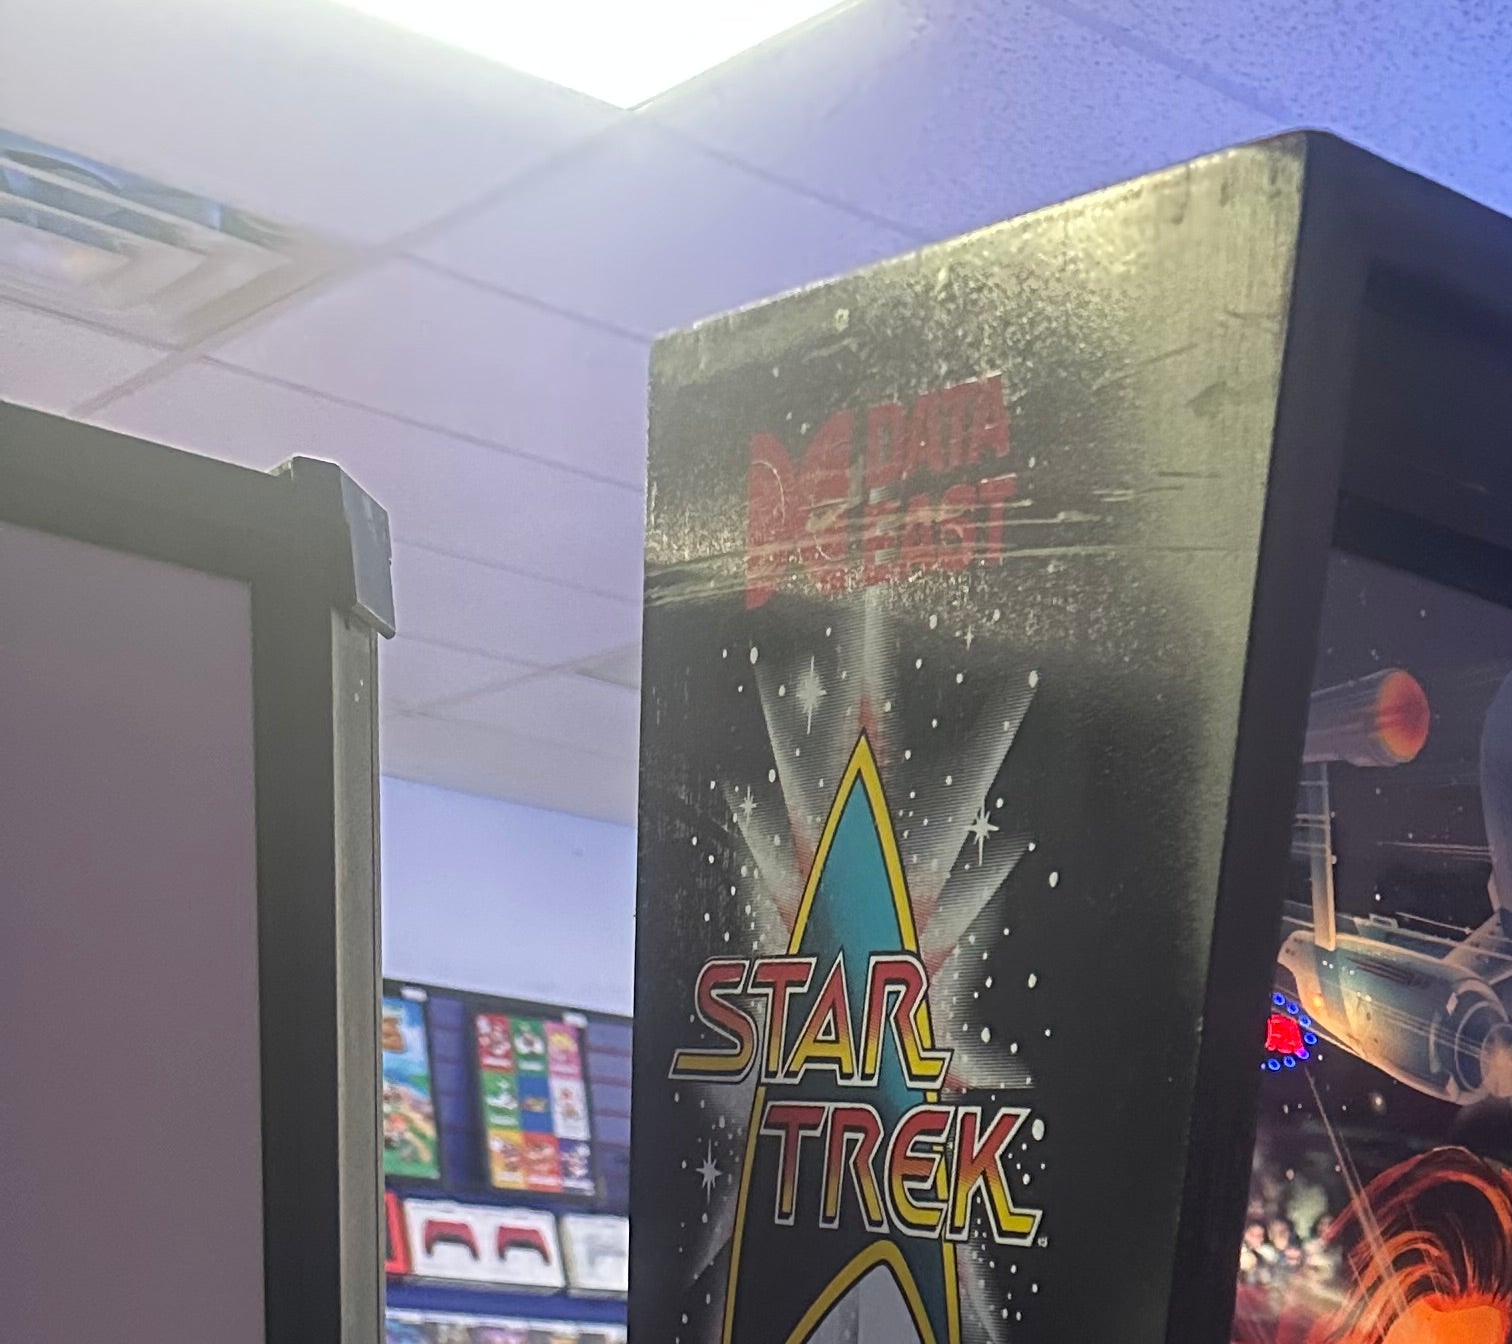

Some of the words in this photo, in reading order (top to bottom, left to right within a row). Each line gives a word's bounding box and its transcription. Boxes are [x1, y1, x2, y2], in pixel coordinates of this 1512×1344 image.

[866, 374, 1011, 487] DATA
[864, 473, 1017, 590] EAST
[668, 950, 954, 1090] STAR
[759, 1100, 1043, 1248] TREK
